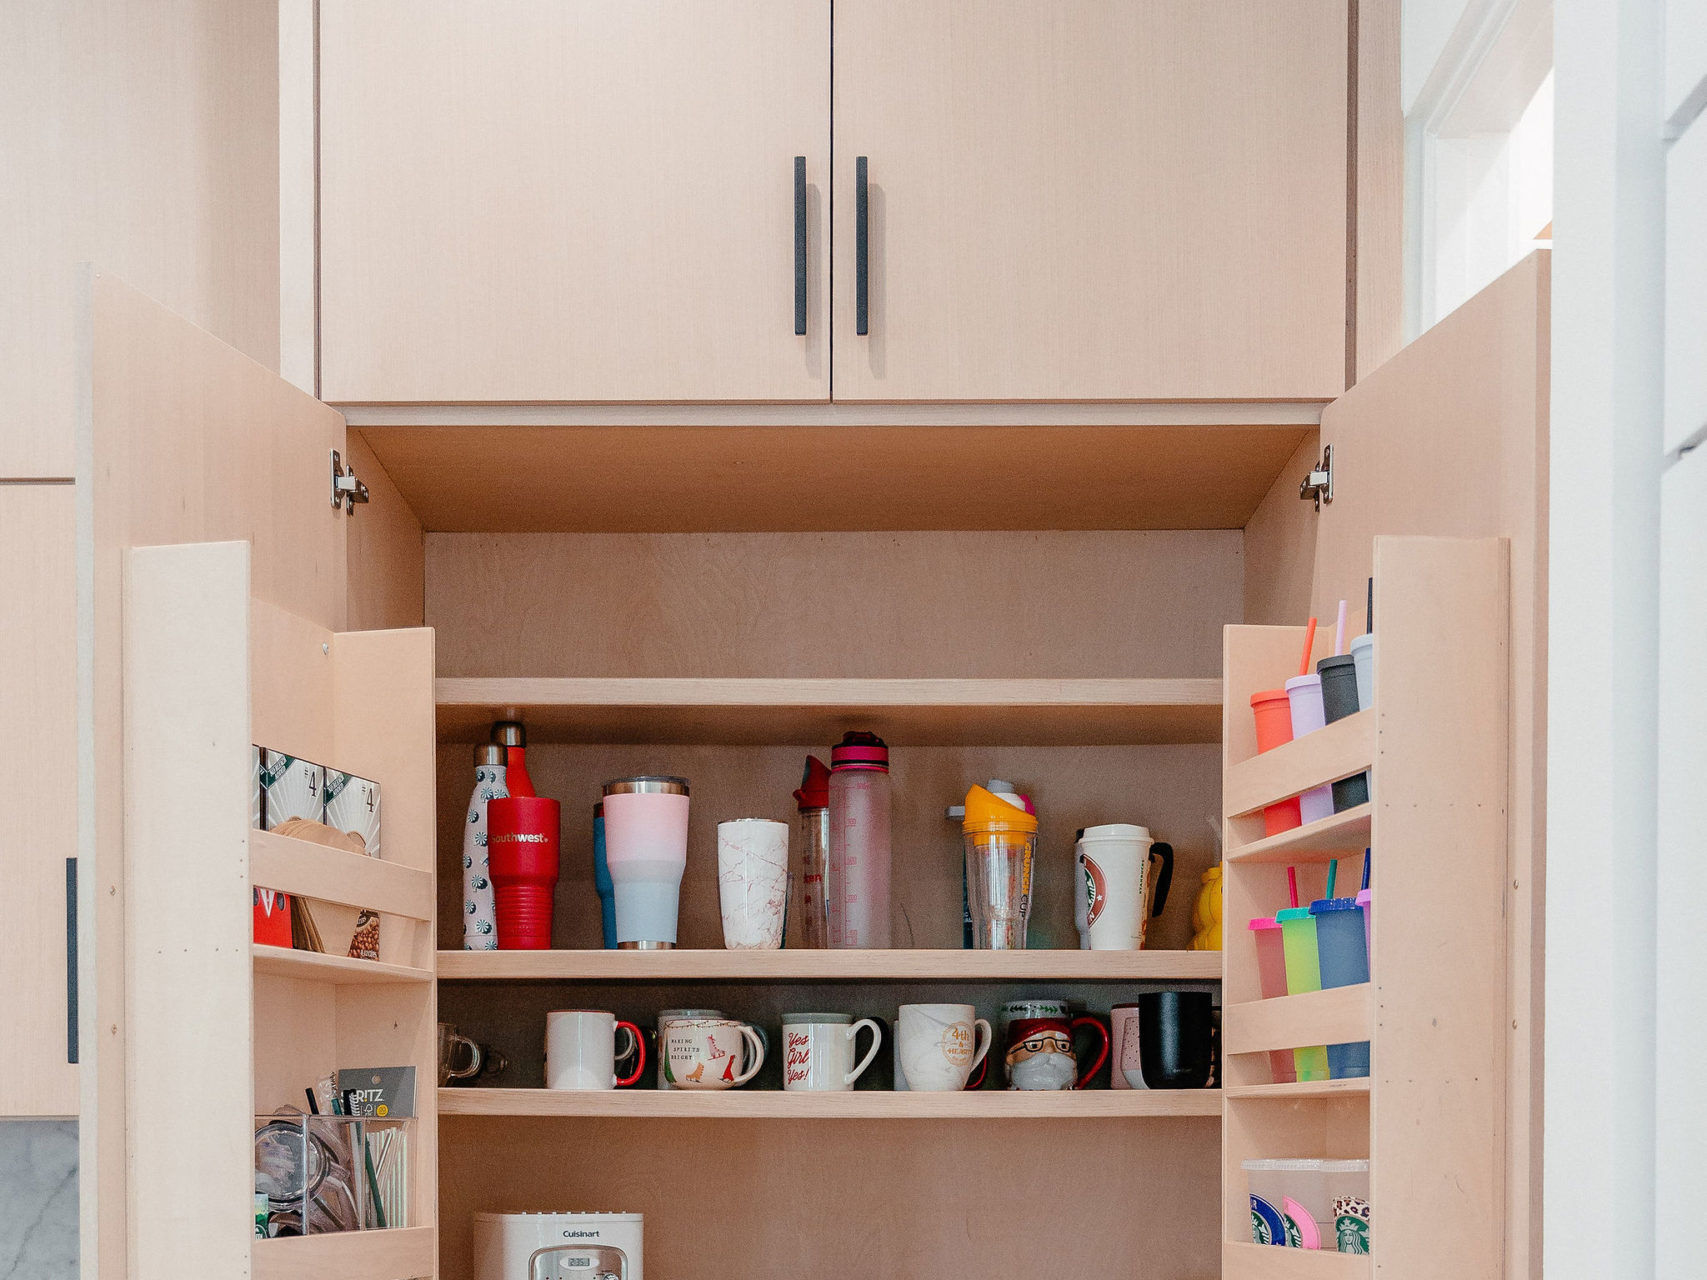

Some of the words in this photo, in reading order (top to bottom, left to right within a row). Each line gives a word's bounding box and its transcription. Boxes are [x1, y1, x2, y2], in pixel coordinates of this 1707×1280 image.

[491, 832, 544, 844] Southwest
[788, 1032, 809, 1049] Yes
[787, 1047, 809, 1070] Girl
[787, 1066, 811, 1085] Yes!
[562, 1230, 600, 1238] Cuisinart
